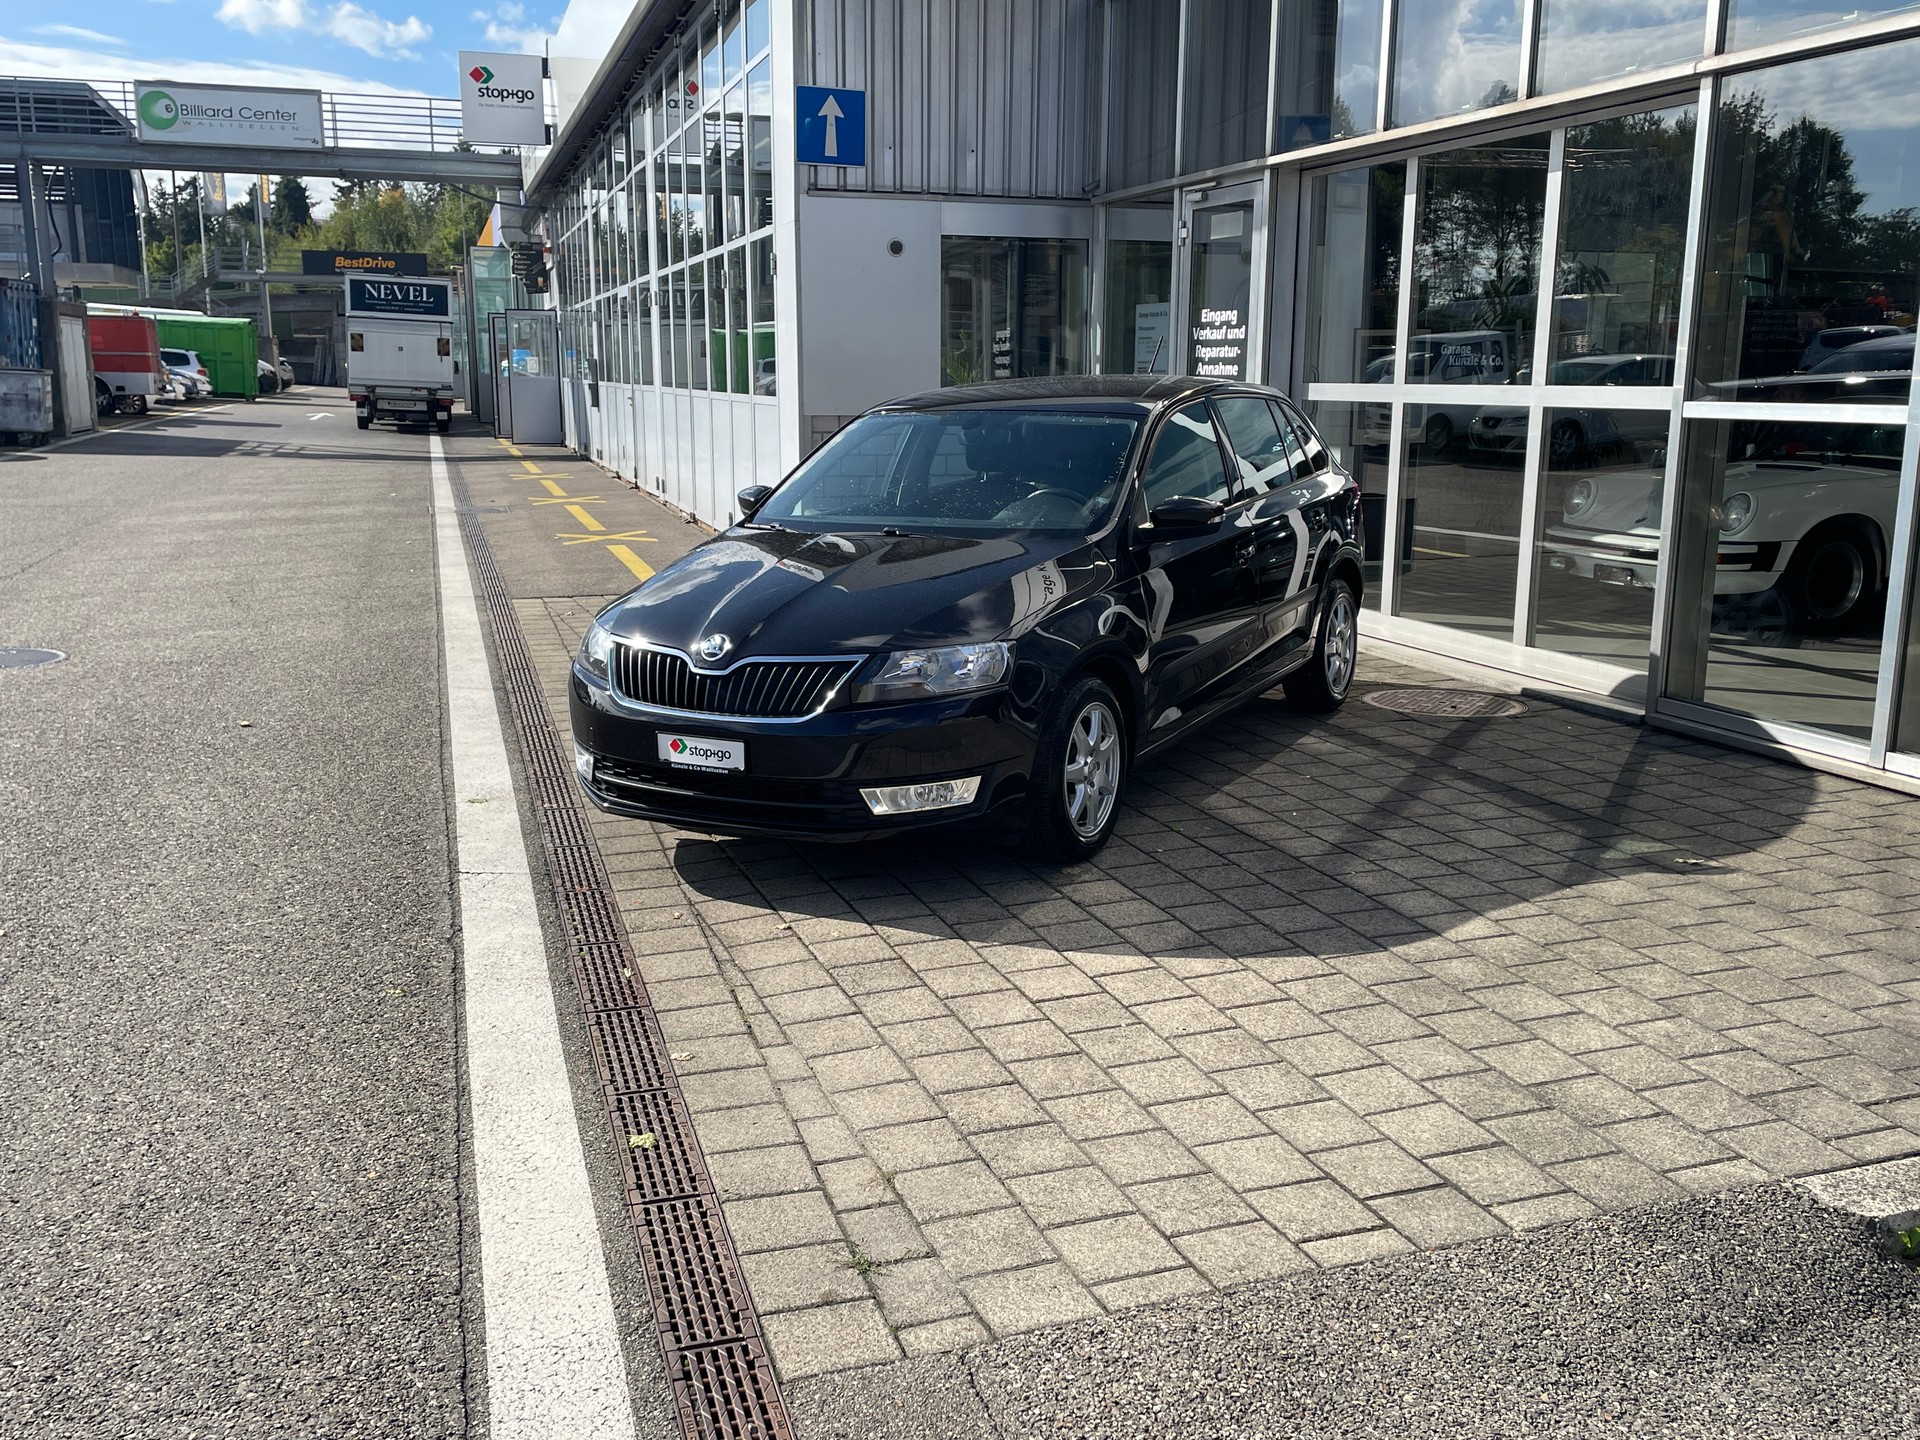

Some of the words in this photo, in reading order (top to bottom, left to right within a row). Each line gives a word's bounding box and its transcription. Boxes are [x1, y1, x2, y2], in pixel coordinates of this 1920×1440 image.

[478, 85, 535, 104] stop+go
[165, 104, 173, 114] 6
[180, 104, 233, 119] Billiard
[238, 106, 298, 122] Center
[182, 120, 299, 131] WALLISELLEN
[335, 256, 396, 269] BestDrive
[365, 283, 434, 302] NEVEL
[1201, 308, 1238, 325] Eingang
[1193, 326, 1227, 340] Verkauf
[1228, 325, 1246, 340] und
[1195, 344, 1241, 361] Reparatur-
[1441, 344, 1472, 357] Garage
[1481, 355, 1488, 365] &
[1489, 355, 1504, 365] Co.
[1196, 362, 1239, 376] Annahme
[689, 746, 732, 762] stop+go
